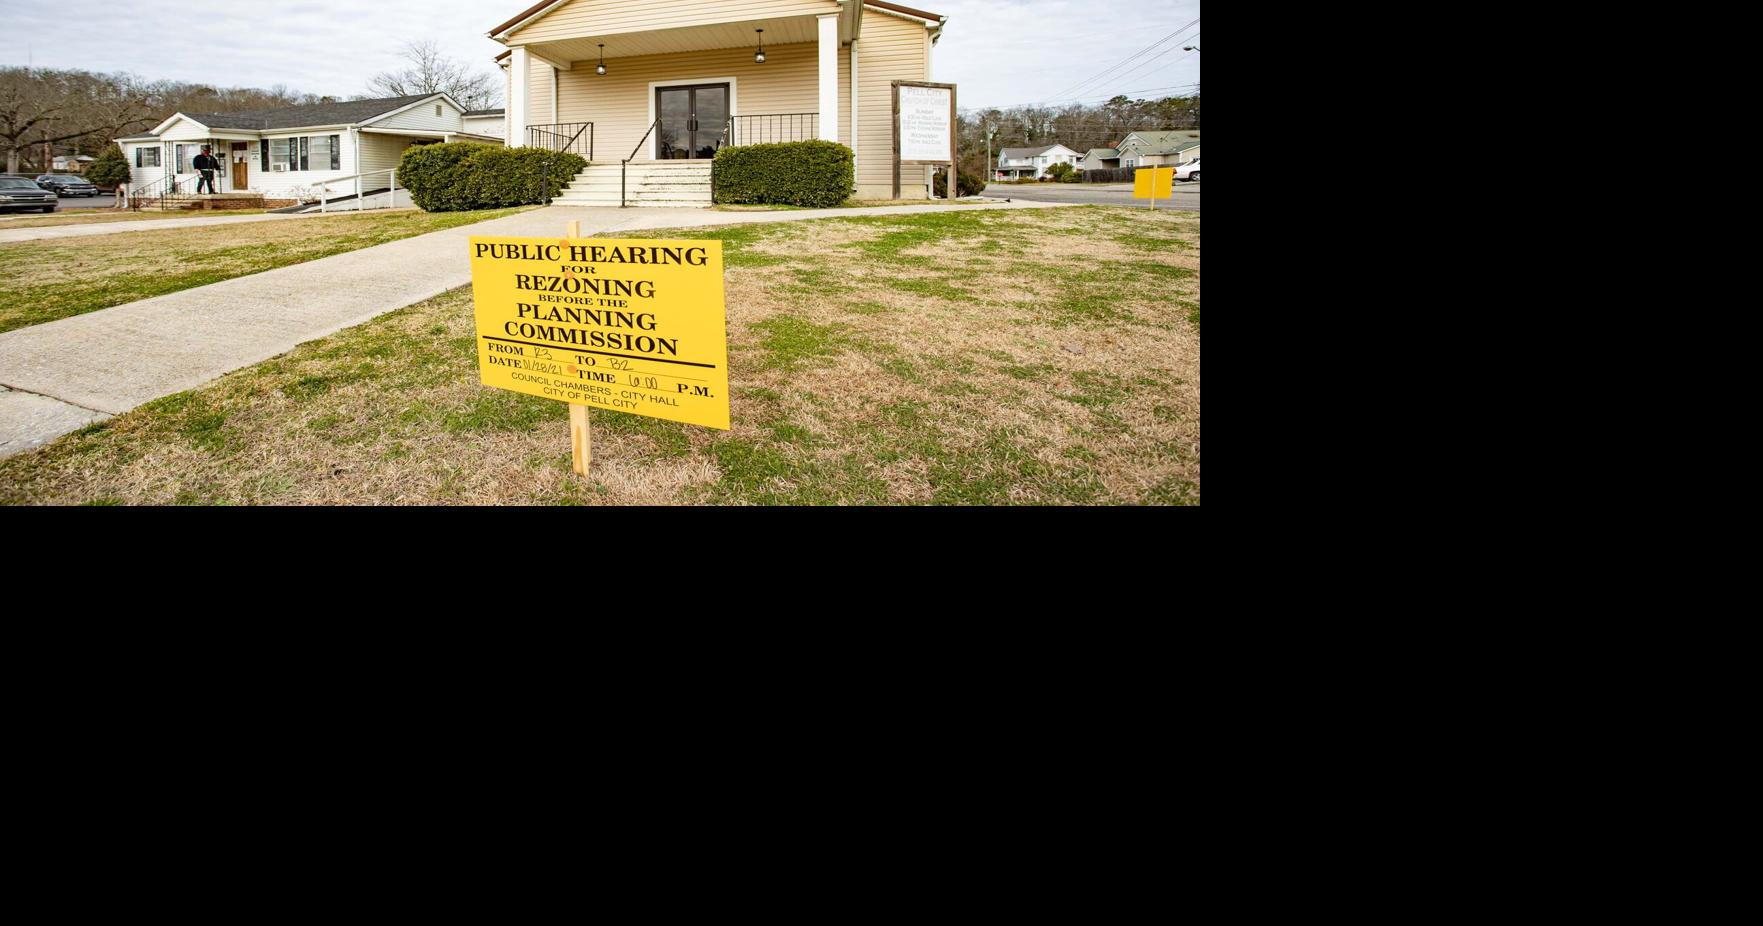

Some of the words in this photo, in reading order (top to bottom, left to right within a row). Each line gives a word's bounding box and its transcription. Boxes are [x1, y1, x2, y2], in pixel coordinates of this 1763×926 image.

[475, 243, 561, 261] PUBLIC
[570, 245, 709, 267] HEARING
[561, 265, 597, 274] FOR
[515, 274, 657, 298] REZONING
[538, 294, 593, 306] BEFORE
[597, 298, 628, 309] THE
[516, 303, 658, 331] PLANNING
[504, 321, 679, 356] COMMISSION
[487, 342, 524, 356] FROM
[575, 354, 596, 367] TO
[607, 357, 634, 371] B2
[488, 355, 522, 369] DATE
[576, 369, 616, 384] TIME
[677, 383, 715, 398] P.M.
[511, 371, 552, 386] COUNCIL
[553, 378, 612, 396] CHAMBERS
[621, 390, 646, 401] CITY
[650, 395, 679, 407] HALL
[543, 386, 565, 397] CITY
[567, 391, 581, 400] OF
[584, 393, 610, 405] PELL
[612, 398, 638, 410] CITY
